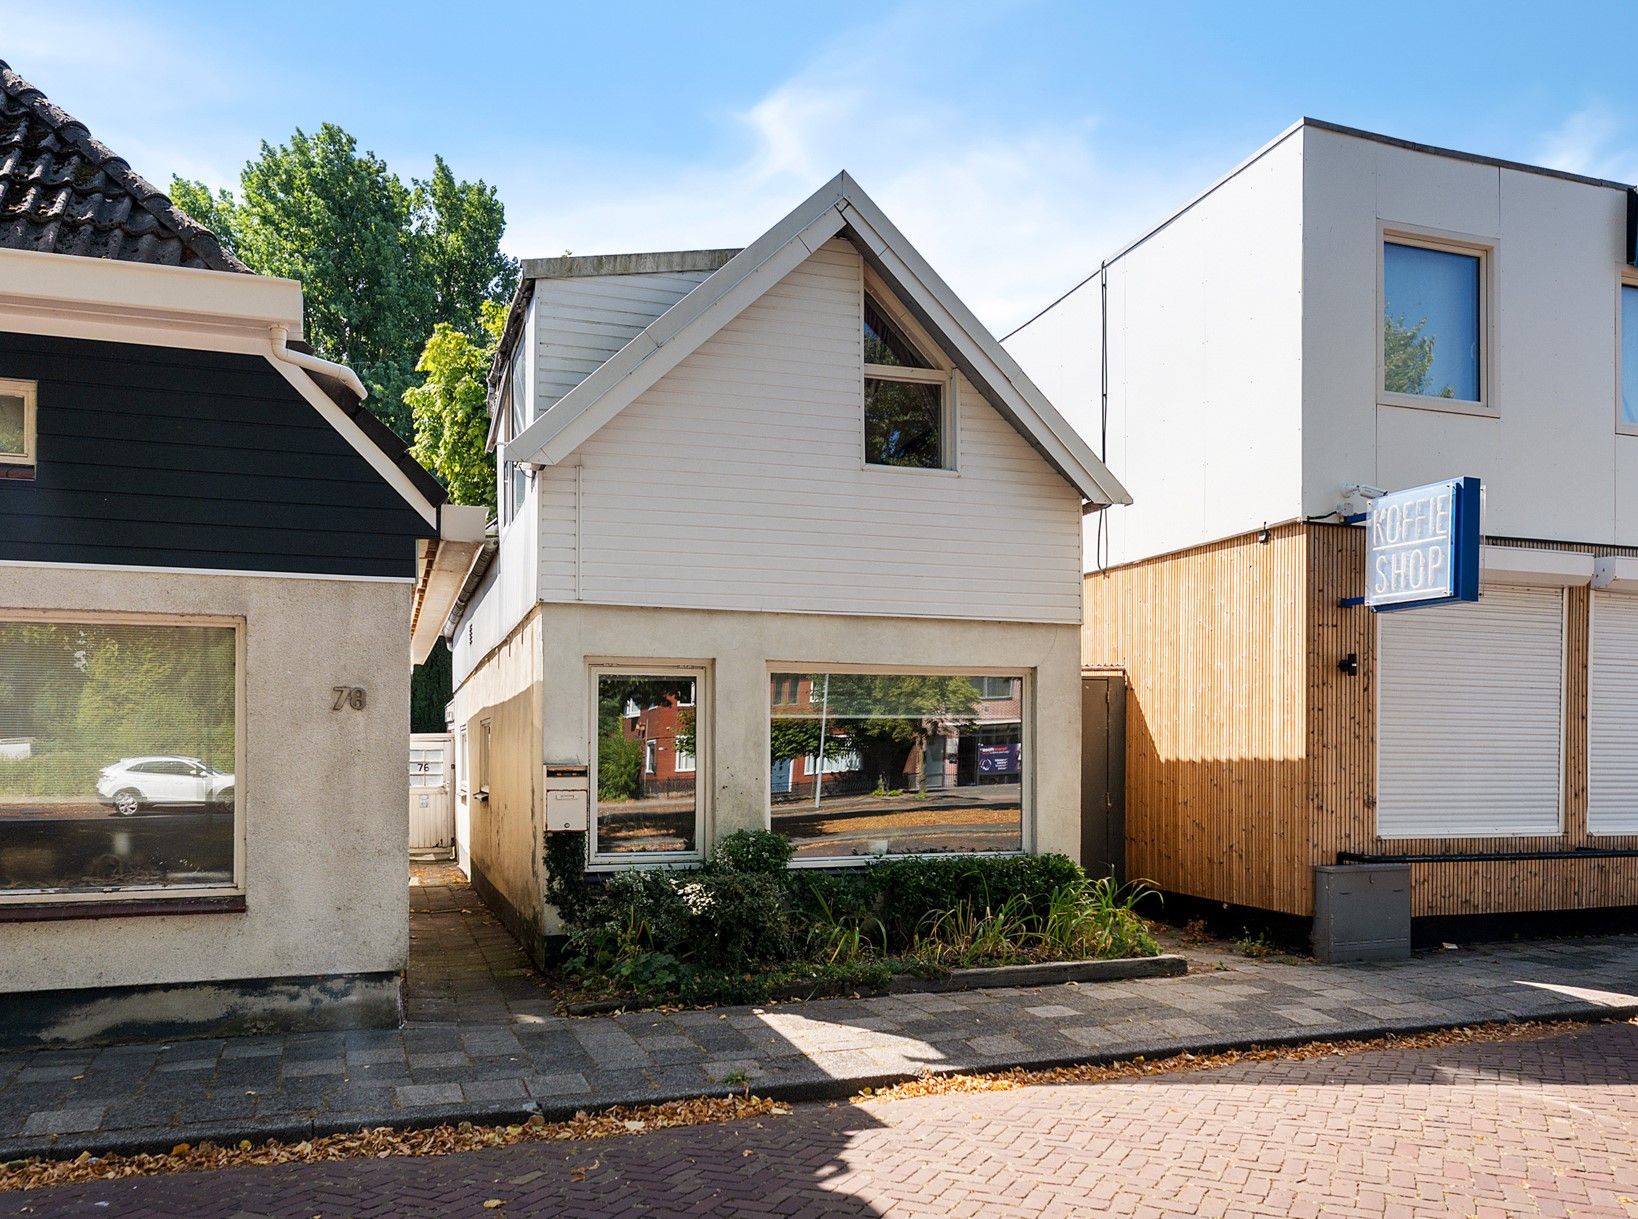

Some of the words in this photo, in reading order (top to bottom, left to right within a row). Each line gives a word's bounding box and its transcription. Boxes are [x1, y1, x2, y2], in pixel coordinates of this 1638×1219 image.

[1373, 494, 1449, 546] KOFFIE
[1375, 546, 1442, 593] SHOP
[417, 763, 430, 772] 76
